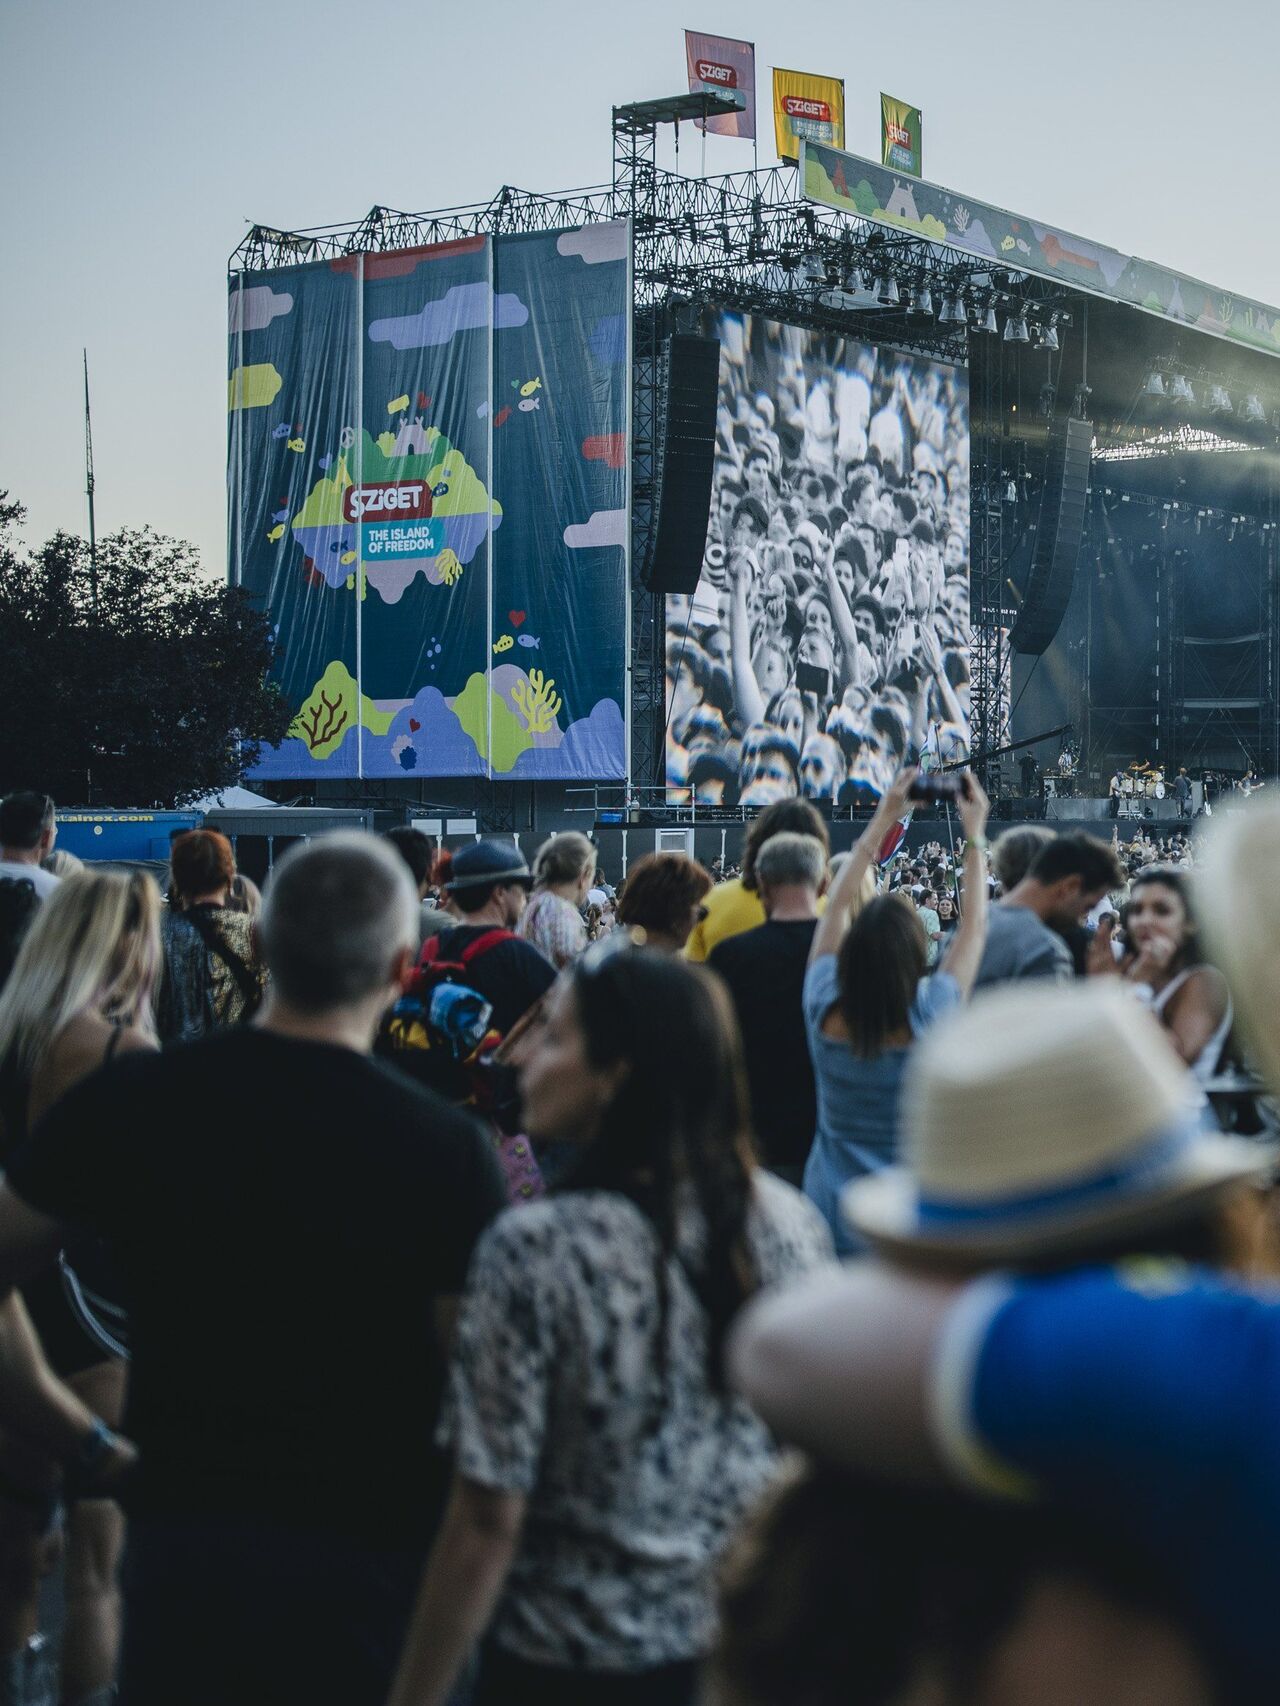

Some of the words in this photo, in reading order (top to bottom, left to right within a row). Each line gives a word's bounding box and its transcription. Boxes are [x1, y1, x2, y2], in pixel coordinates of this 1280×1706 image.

[700, 63, 732, 81] SZiGET
[787, 99, 825, 116] SZiGET
[350, 485, 423, 518] SZiGET
[369, 530, 389, 541] THE
[391, 527, 429, 540] ISLAND
[368, 542, 382, 553] OF
[384, 538, 434, 552] FREEDOM
